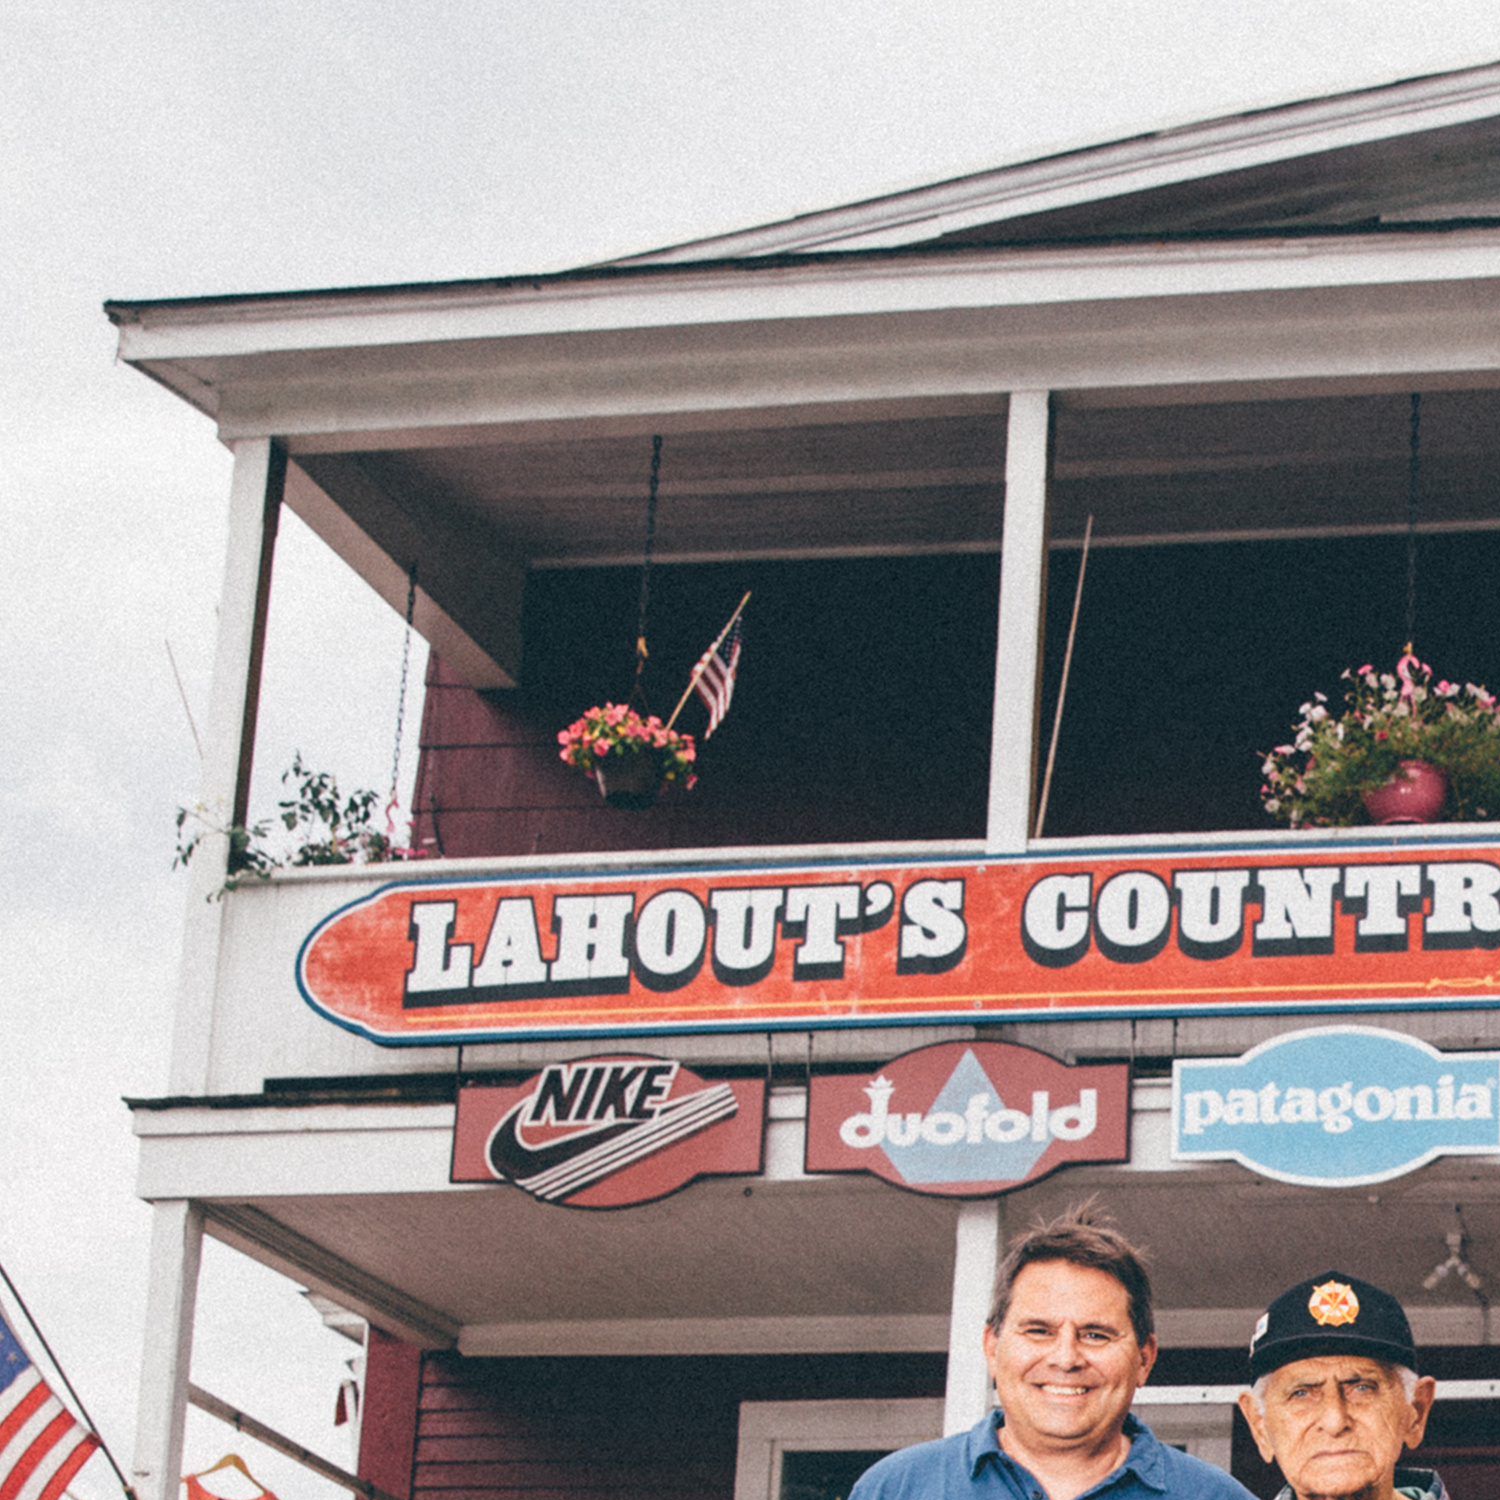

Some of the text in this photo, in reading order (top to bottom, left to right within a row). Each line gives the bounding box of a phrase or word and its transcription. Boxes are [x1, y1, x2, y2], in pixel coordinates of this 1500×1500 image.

[405, 876, 967, 1006] LAHOUT'S
[527, 1060, 680, 1126] NIKE
[839, 1080, 1099, 1150] duofold
[1182, 1074, 1494, 1135] patagonia
